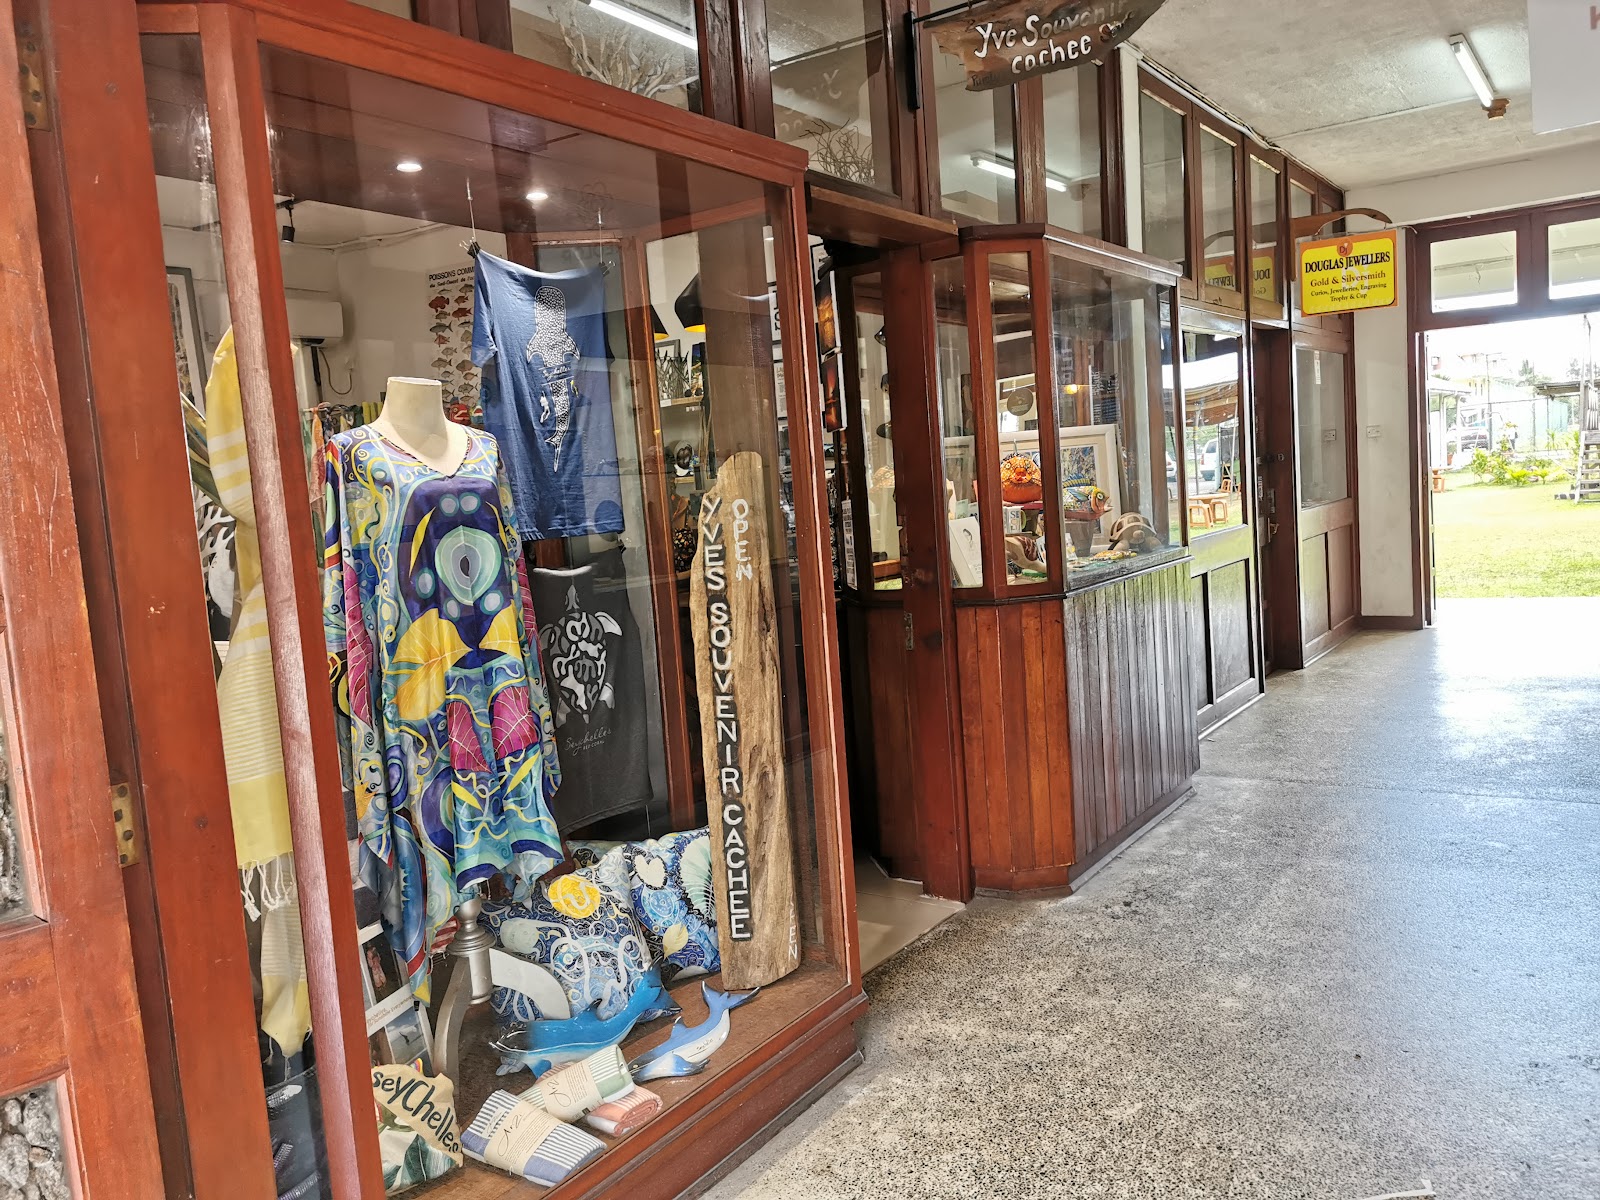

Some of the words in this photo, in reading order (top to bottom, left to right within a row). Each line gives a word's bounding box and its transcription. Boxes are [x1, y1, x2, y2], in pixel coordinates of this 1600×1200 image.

[974, 22, 1017, 58] Yve
[428, 270, 456, 281] POISSONS
[1305, 257, 1344, 274] DOUGLAS
[1345, 251, 1391, 270] JEWELLERS
[1310, 277, 1329, 287] Gold
[1331, 276, 1339, 284] &
[1341, 270, 1386, 284] Silversmith
[1360, 282, 1387, 291] Engraving
[1330, 294, 1348, 302] Trophy
[703, 497, 725, 591] YVES
[732, 498, 753, 582] OPEN
[710, 602, 741, 794] SOUVENIR
[564, 727, 611, 756] Seychelles
[723, 804, 751, 939] CACHEE
